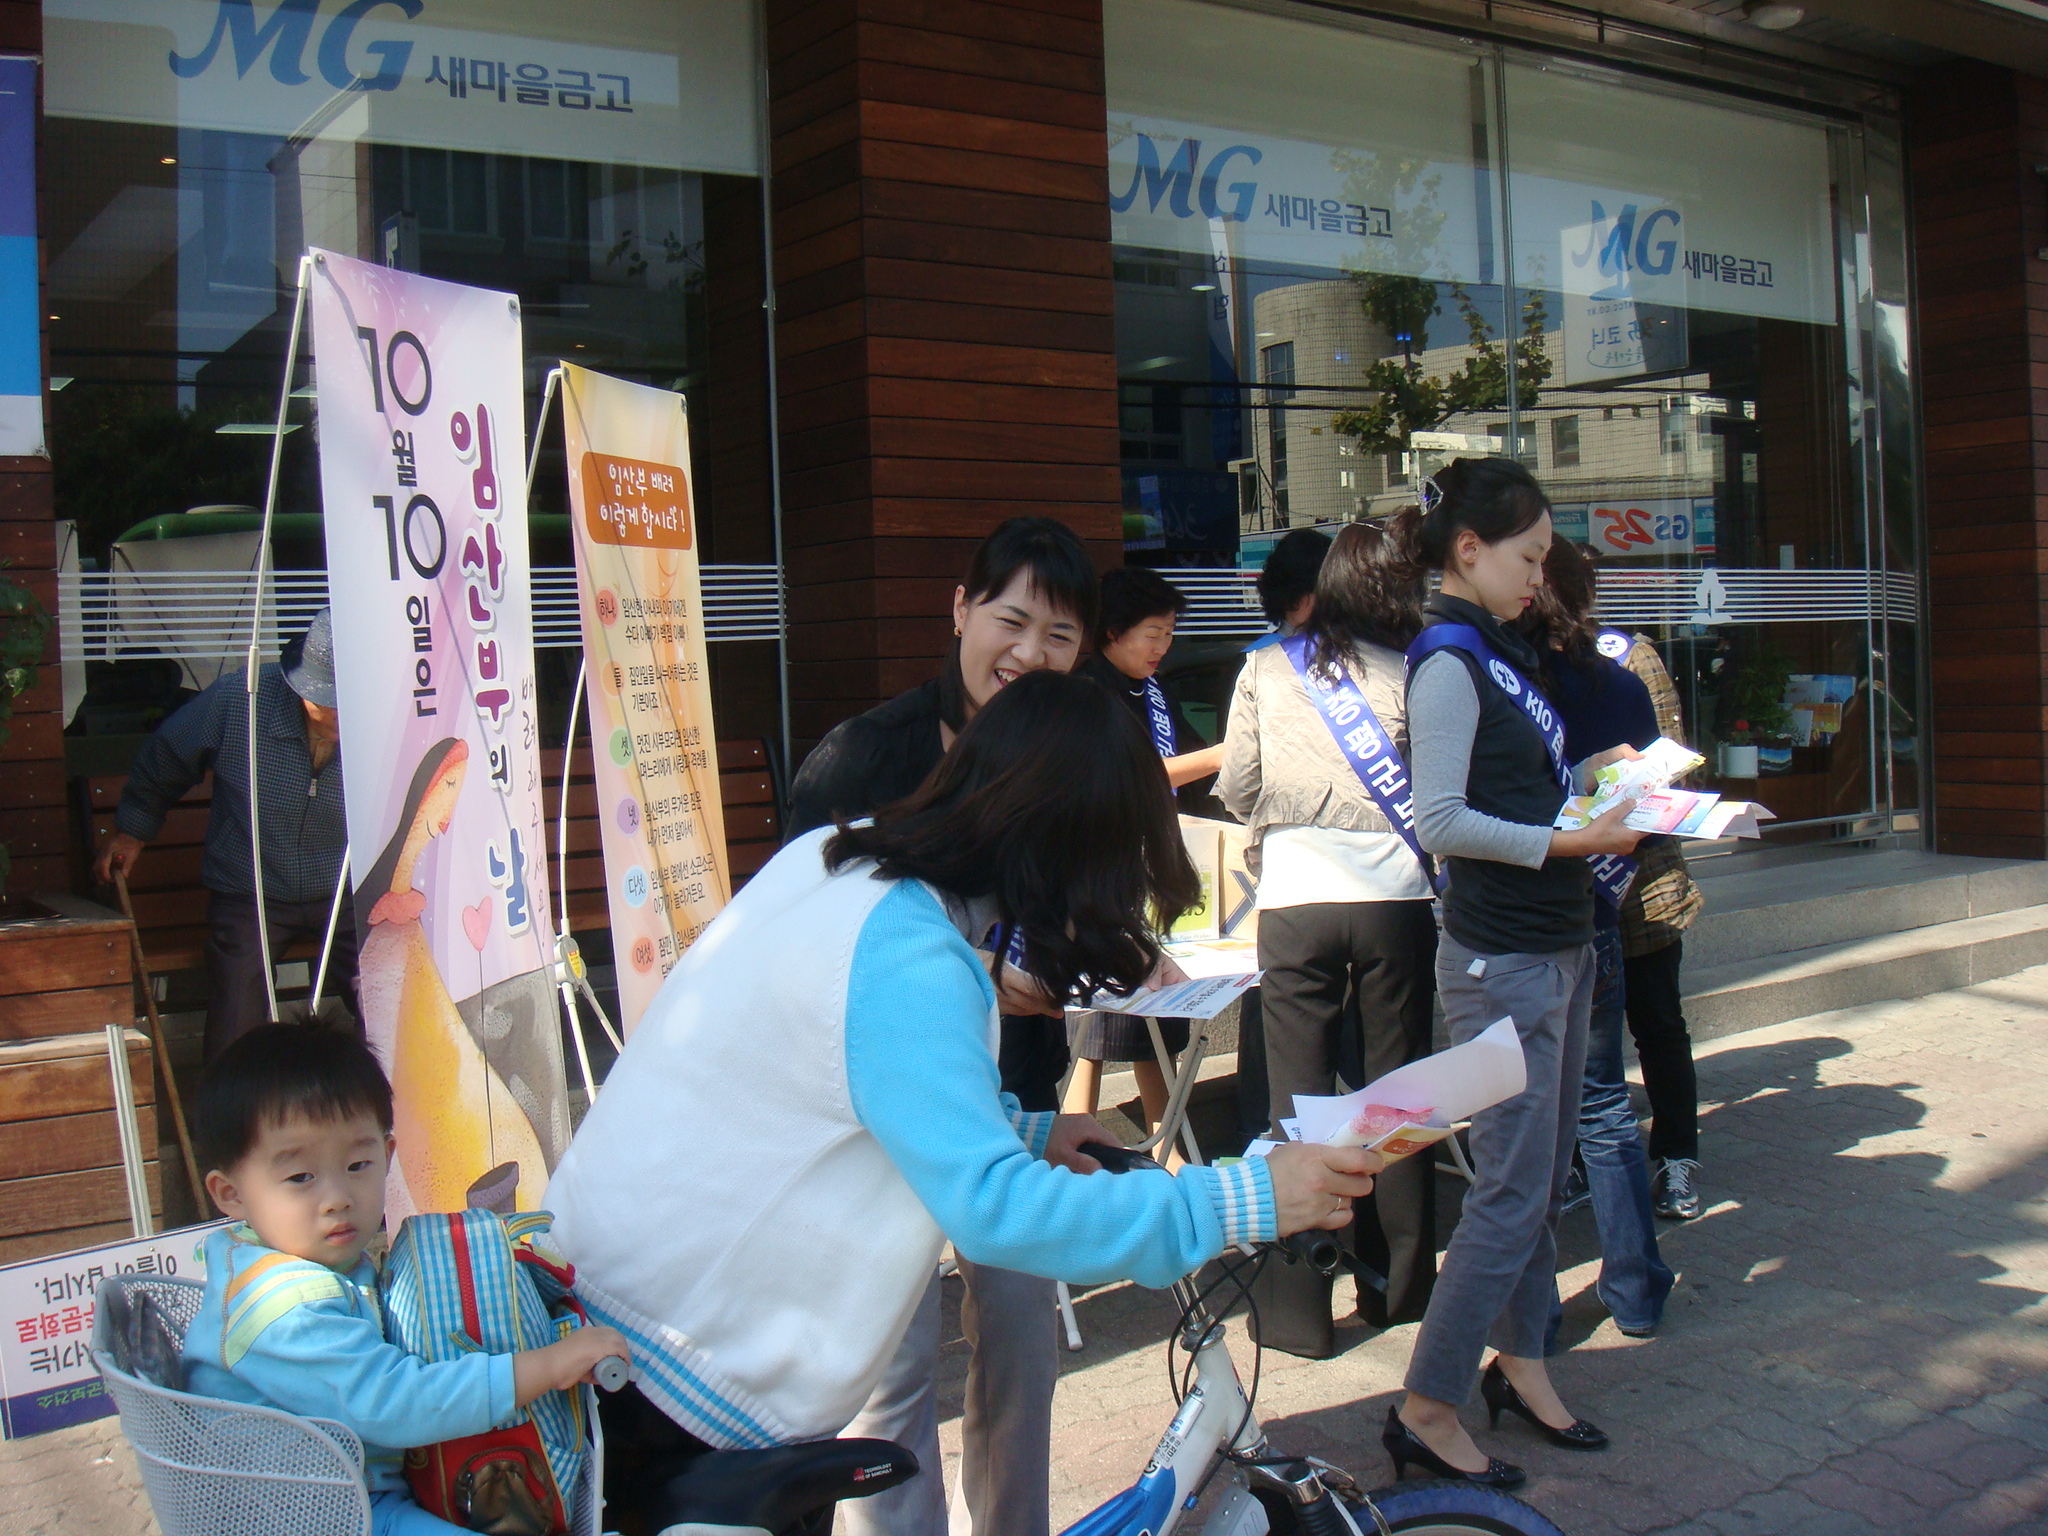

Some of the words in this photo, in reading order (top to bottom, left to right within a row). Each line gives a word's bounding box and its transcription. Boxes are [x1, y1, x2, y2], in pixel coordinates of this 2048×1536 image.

[168, 0, 424, 92] MG
[424, 55, 634, 114] 새마을금고
[1109, 133, 1262, 222] MG
[1265, 194, 1393, 239] 새마을금고
[1571, 200, 1681, 276] MG
[1682, 250, 1774, 288] 새마을금고
[608, 463, 648, 498] 임산부
[650, 472, 675, 494] 배려
[600, 502, 640, 538] 이렇게
[1147, 684, 1176, 757] 증평군
[636, 732, 652, 755] 멋진
[671, 793, 690, 815] 무거운
[661, 823, 675, 845] 먼저
[488, 827, 528, 928] 날
[29, 1340, 92, 1374] 서가는
[37, 1382, 112, 1409] 군보건소
